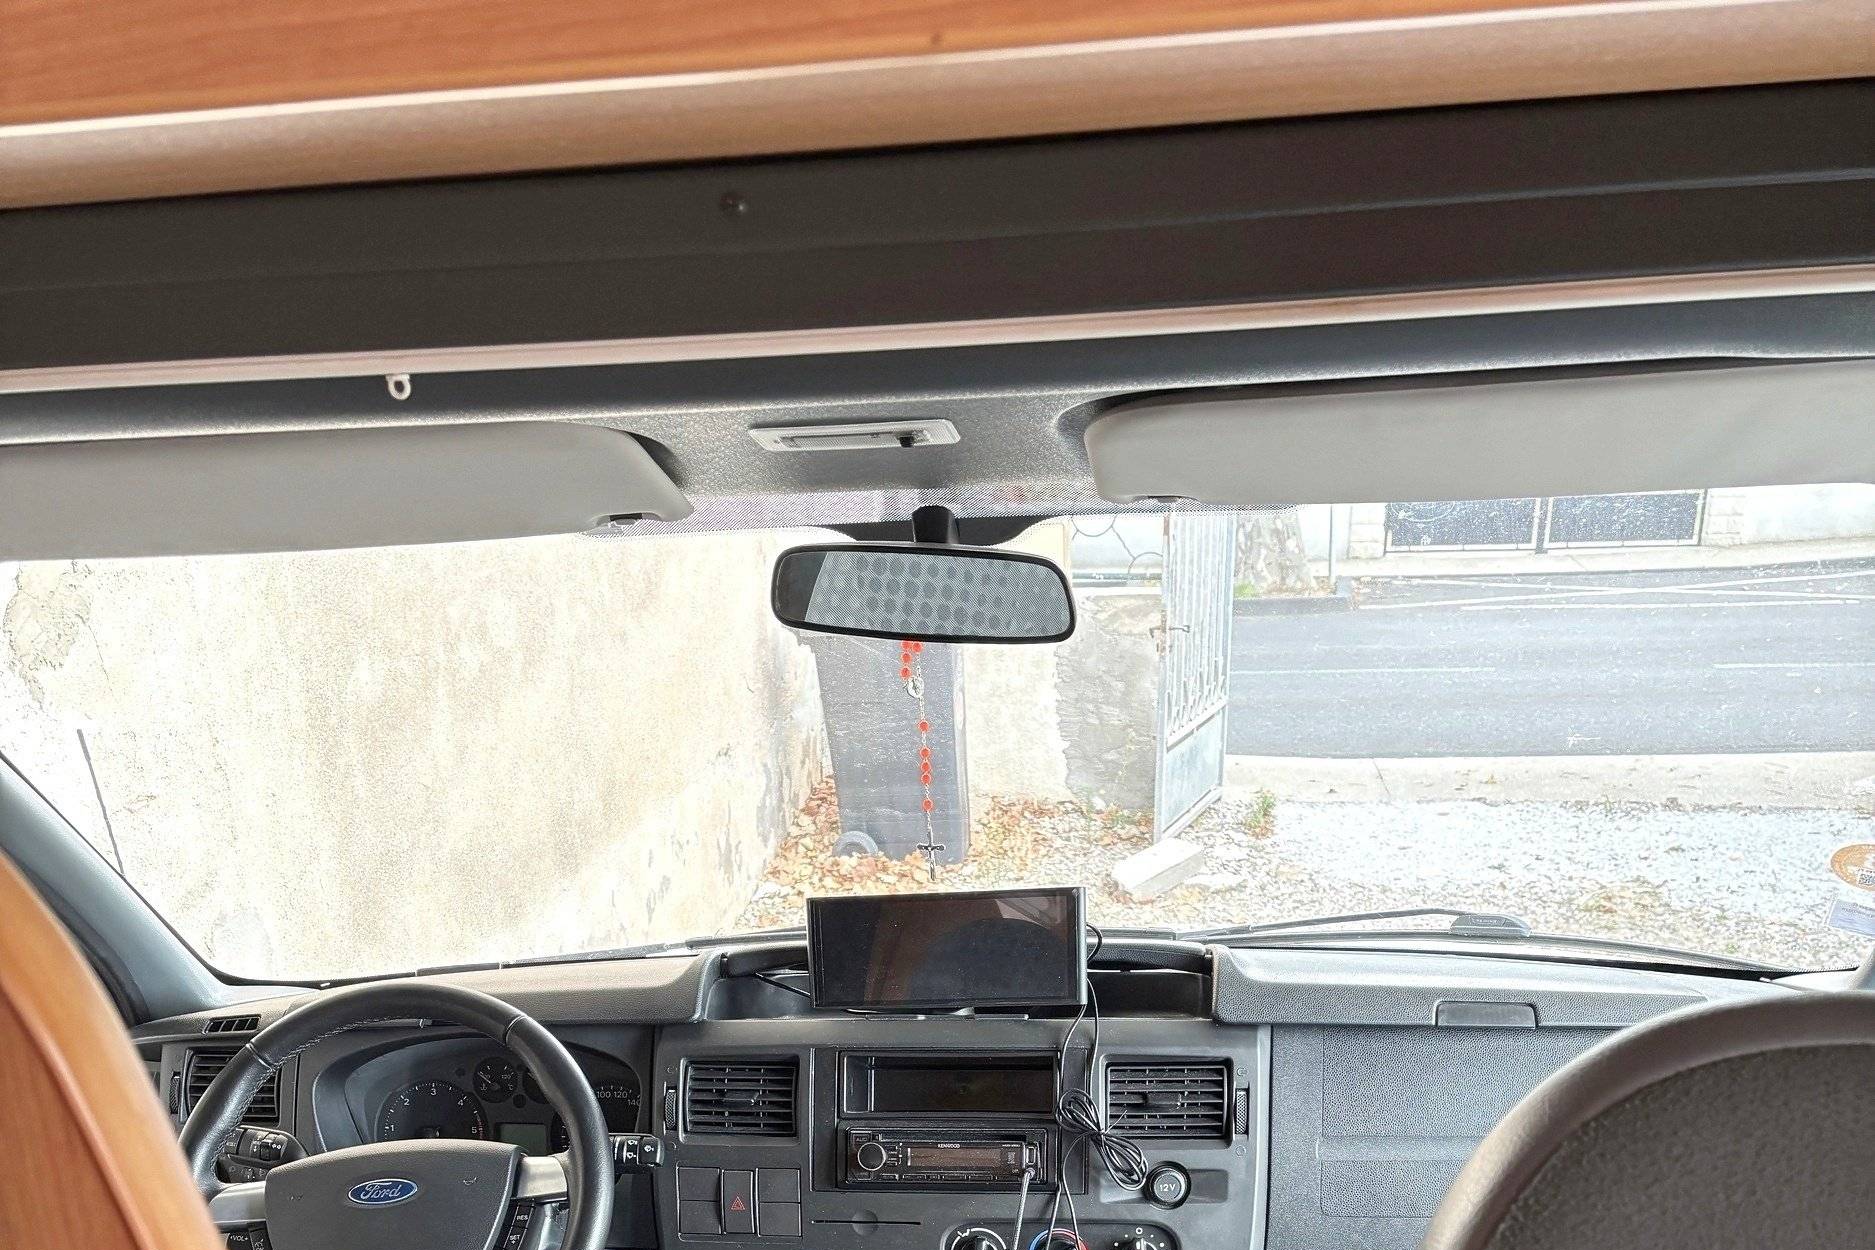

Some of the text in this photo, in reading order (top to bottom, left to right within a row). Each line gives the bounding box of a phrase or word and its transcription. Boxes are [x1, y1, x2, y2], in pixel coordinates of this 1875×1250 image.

[430, 1088, 437, 1096] 3
[597, 1091, 612, 1099] 100
[614, 1091, 628, 1099] 120
[403, 1098, 410, 1106] 2
[390, 1124, 395, 1132] 1
[471, 1126, 478, 1134] 5
[360, 1182, 402, 1200] Ford
[1159, 1183, 1176, 1192] 12V
